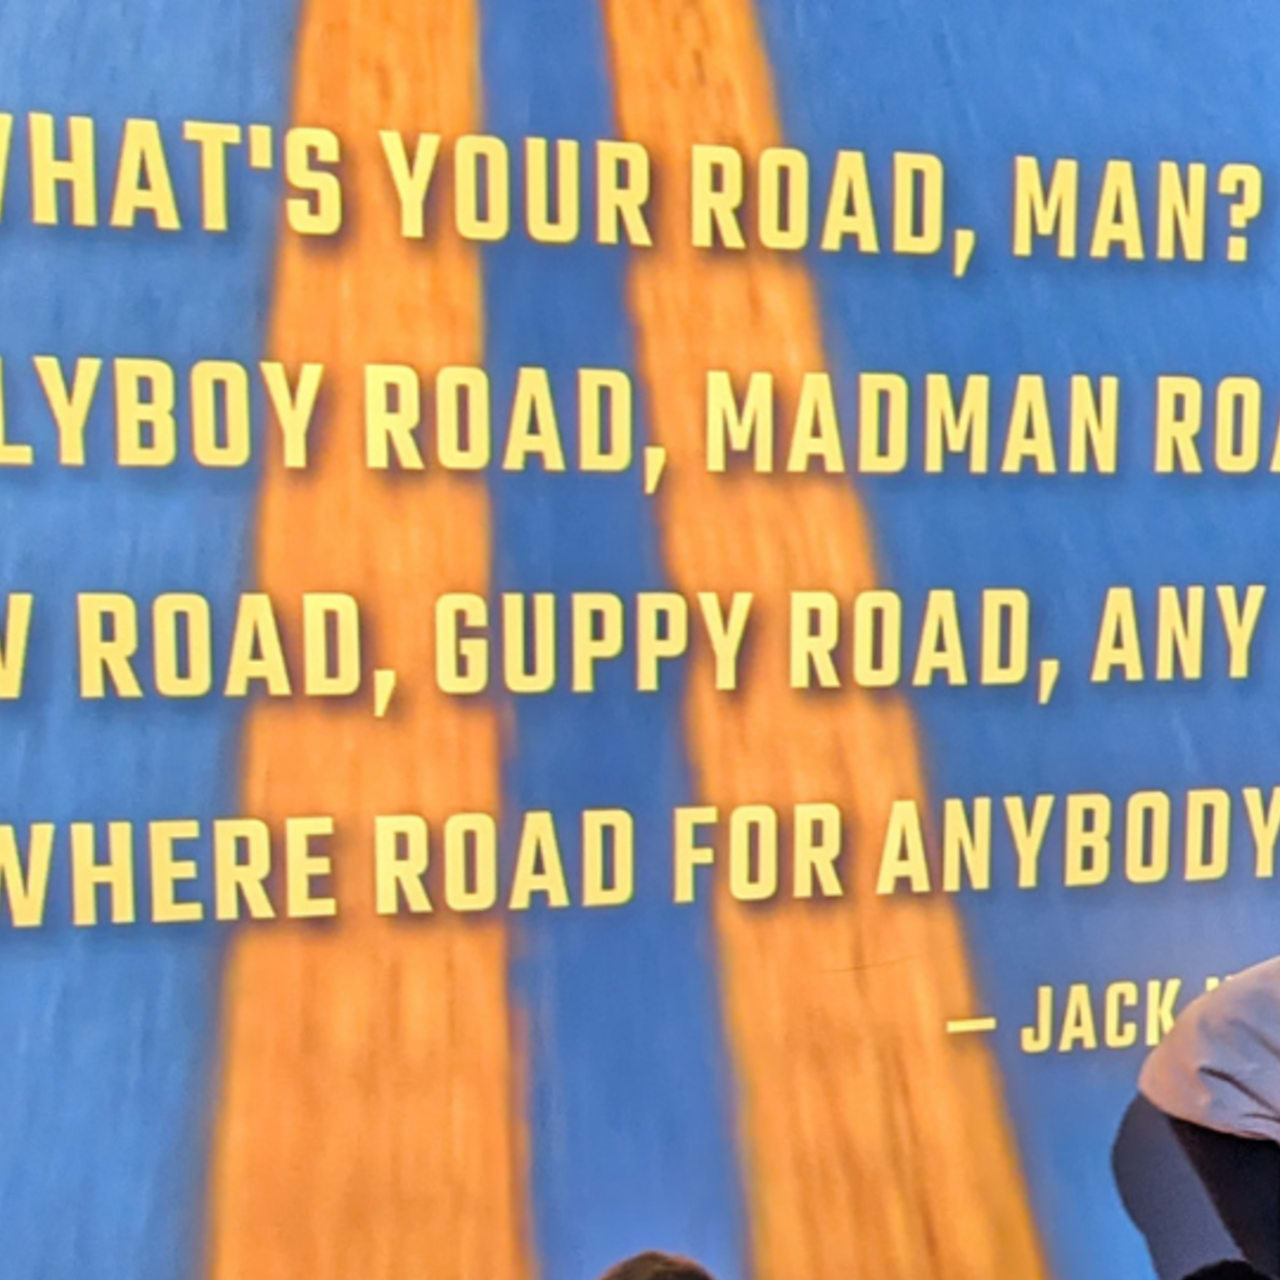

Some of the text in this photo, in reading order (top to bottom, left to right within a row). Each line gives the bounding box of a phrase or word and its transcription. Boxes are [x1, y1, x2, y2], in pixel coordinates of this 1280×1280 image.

[378, 129, 653, 247] YOUR
[691, 144, 975, 277] ROAD,
[1013, 156, 1263, 262] MAN?
[362, 363, 668, 494] ROAD,
[705, 370, 1119, 474] MADMAN
[77, 593, 398, 718] ROAD,
[434, 592, 755, 694] GUPPY
[789, 590, 1061, 704] ROAD,
[1091, 585, 1266, 682] ANY
[373, 809, 634, 915] ROAD
[674, 803, 844, 903] FOR
[1020, 978, 1182, 1054] JACK
